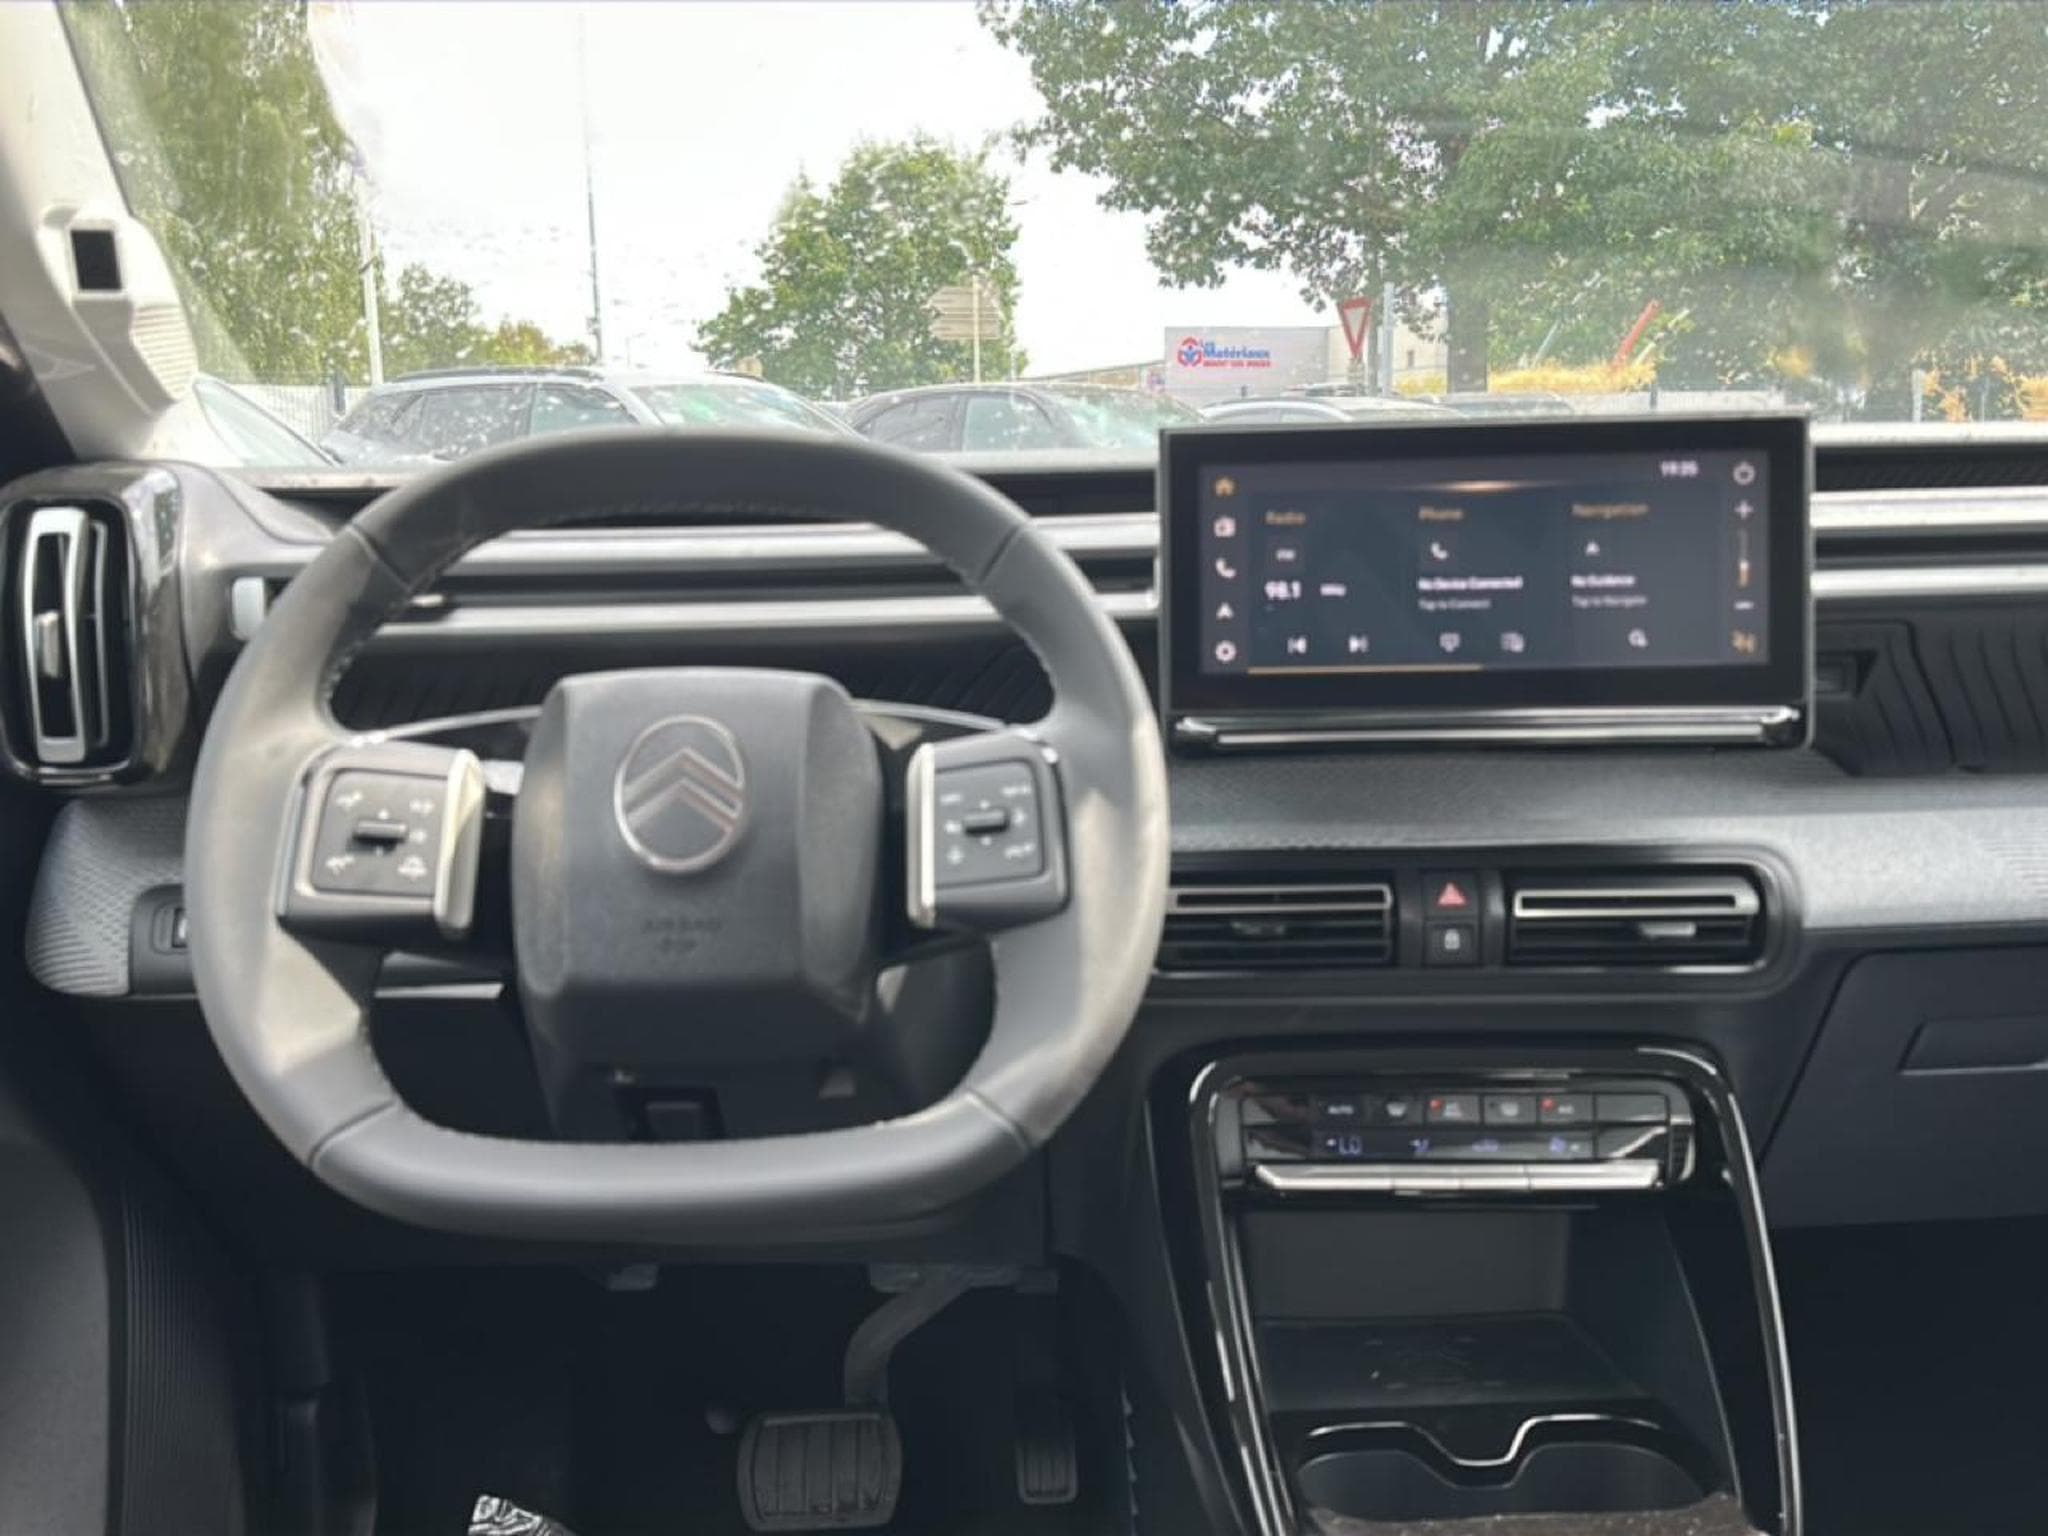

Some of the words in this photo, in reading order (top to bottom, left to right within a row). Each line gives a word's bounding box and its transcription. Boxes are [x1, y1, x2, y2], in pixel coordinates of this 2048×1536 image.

[1265, 510, 1306, 526] Radio
[1418, 507, 1464, 521] Phone
[1571, 503, 1649, 519] Navigation
